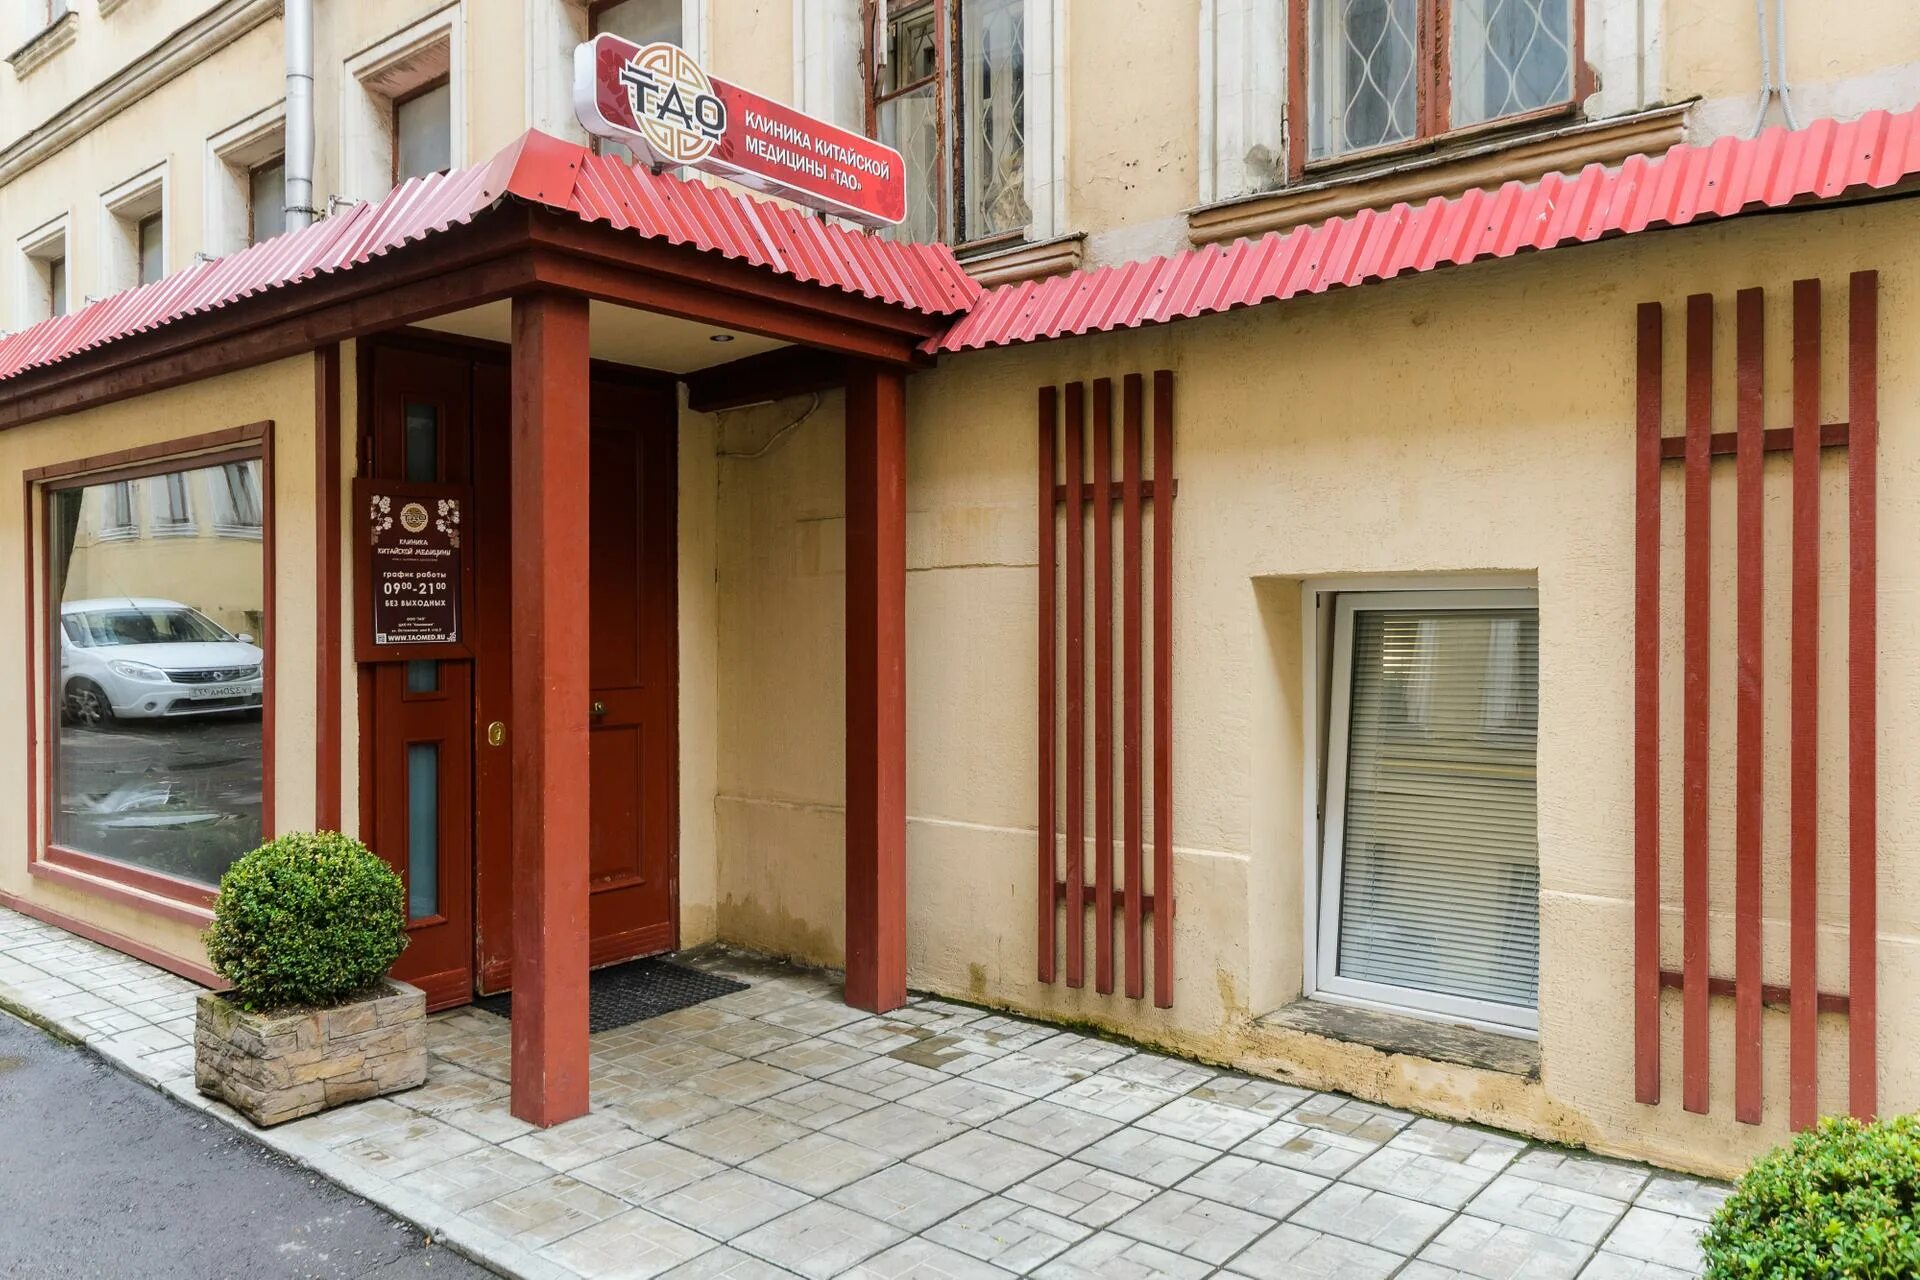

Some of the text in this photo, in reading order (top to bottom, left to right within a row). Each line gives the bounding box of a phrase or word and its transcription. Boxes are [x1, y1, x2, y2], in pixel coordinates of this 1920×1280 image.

[621, 64, 725, 138] ТАО
[745, 110, 890, 180] КЛИНИКА КИТАЙСКОЙ
[745, 135, 862, 192] МЕДИЦИНЫ «ТАО»
[378, 547, 451, 558] КИТАЙСКОЙ МЕДИЦИНЫ
[383, 571, 447, 579] график работы
